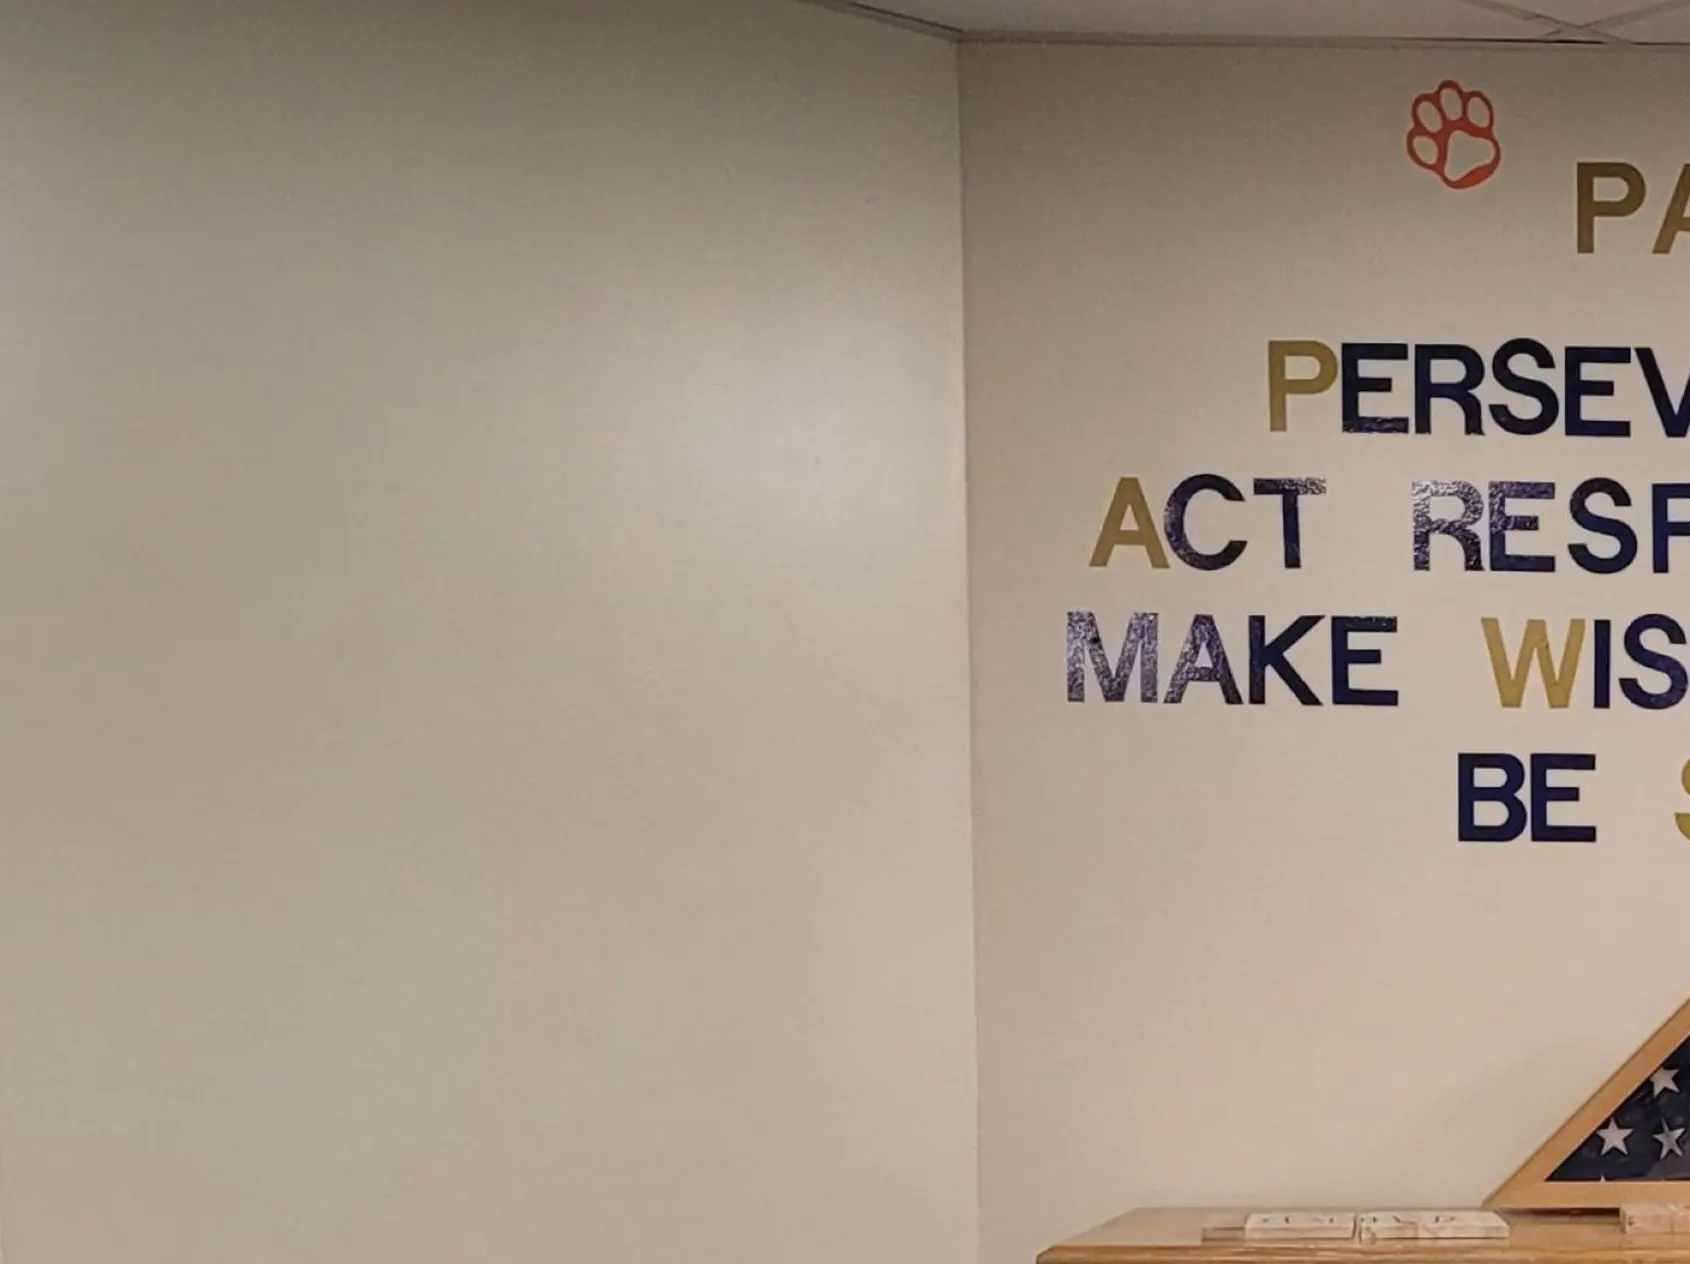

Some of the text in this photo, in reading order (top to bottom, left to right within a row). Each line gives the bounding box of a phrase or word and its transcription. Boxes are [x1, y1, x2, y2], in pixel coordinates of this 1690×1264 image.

[1089, 473, 1327, 571] ACT
[1066, 611, 1399, 706] MAKE
[1457, 752, 1598, 843] BE
